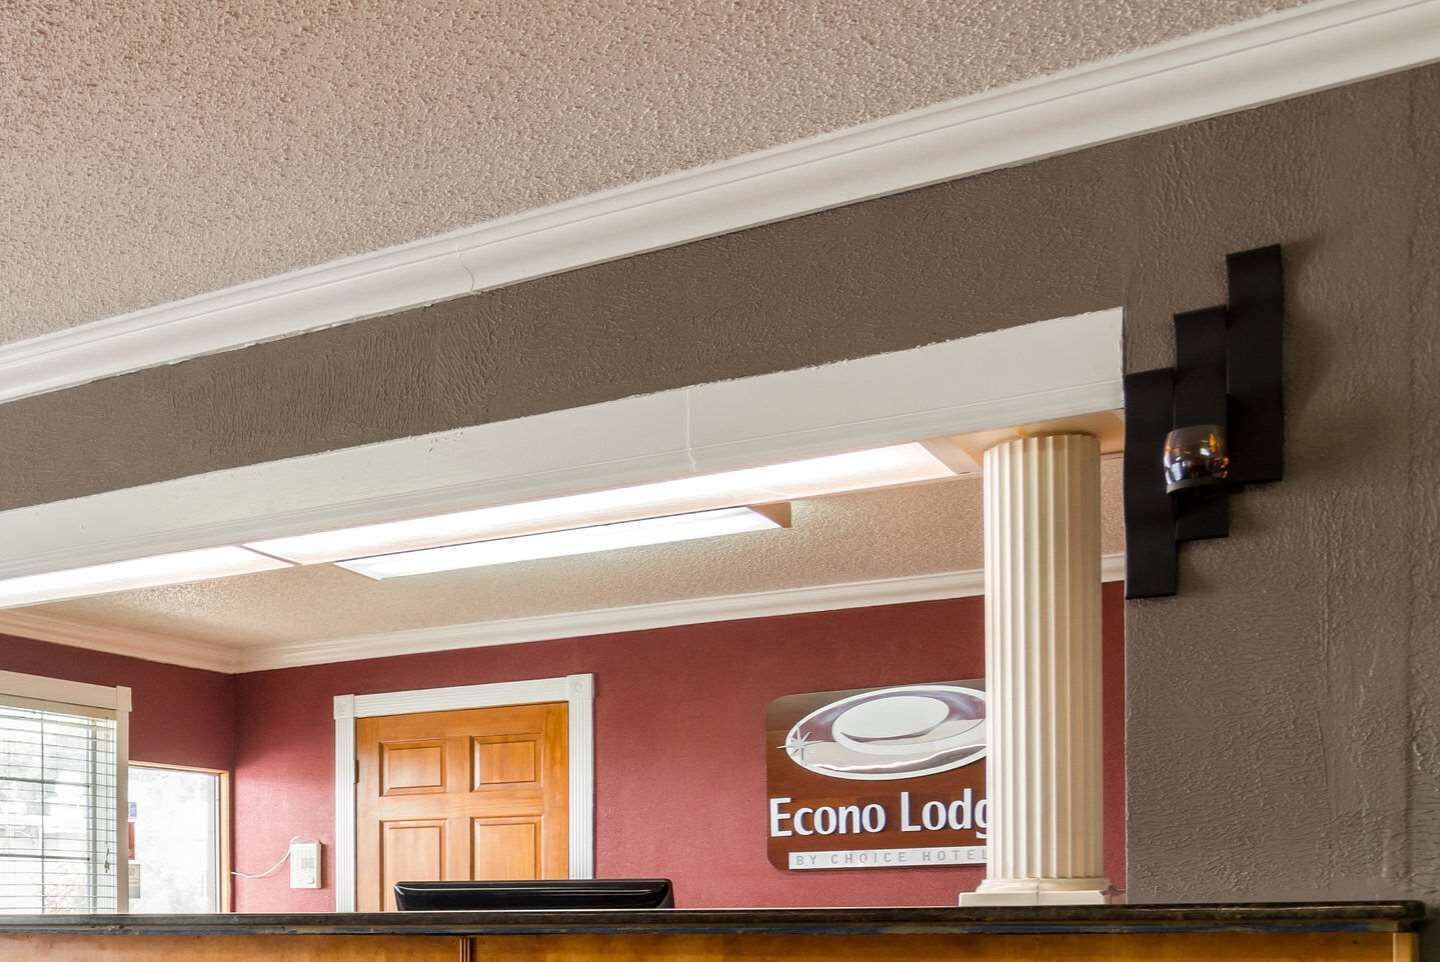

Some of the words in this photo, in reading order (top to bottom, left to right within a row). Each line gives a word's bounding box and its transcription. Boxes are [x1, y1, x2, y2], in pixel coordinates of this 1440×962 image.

[769, 797, 886, 837] Econo
[796, 855, 816, 866] BY
[830, 851, 907, 865] CHOICE
